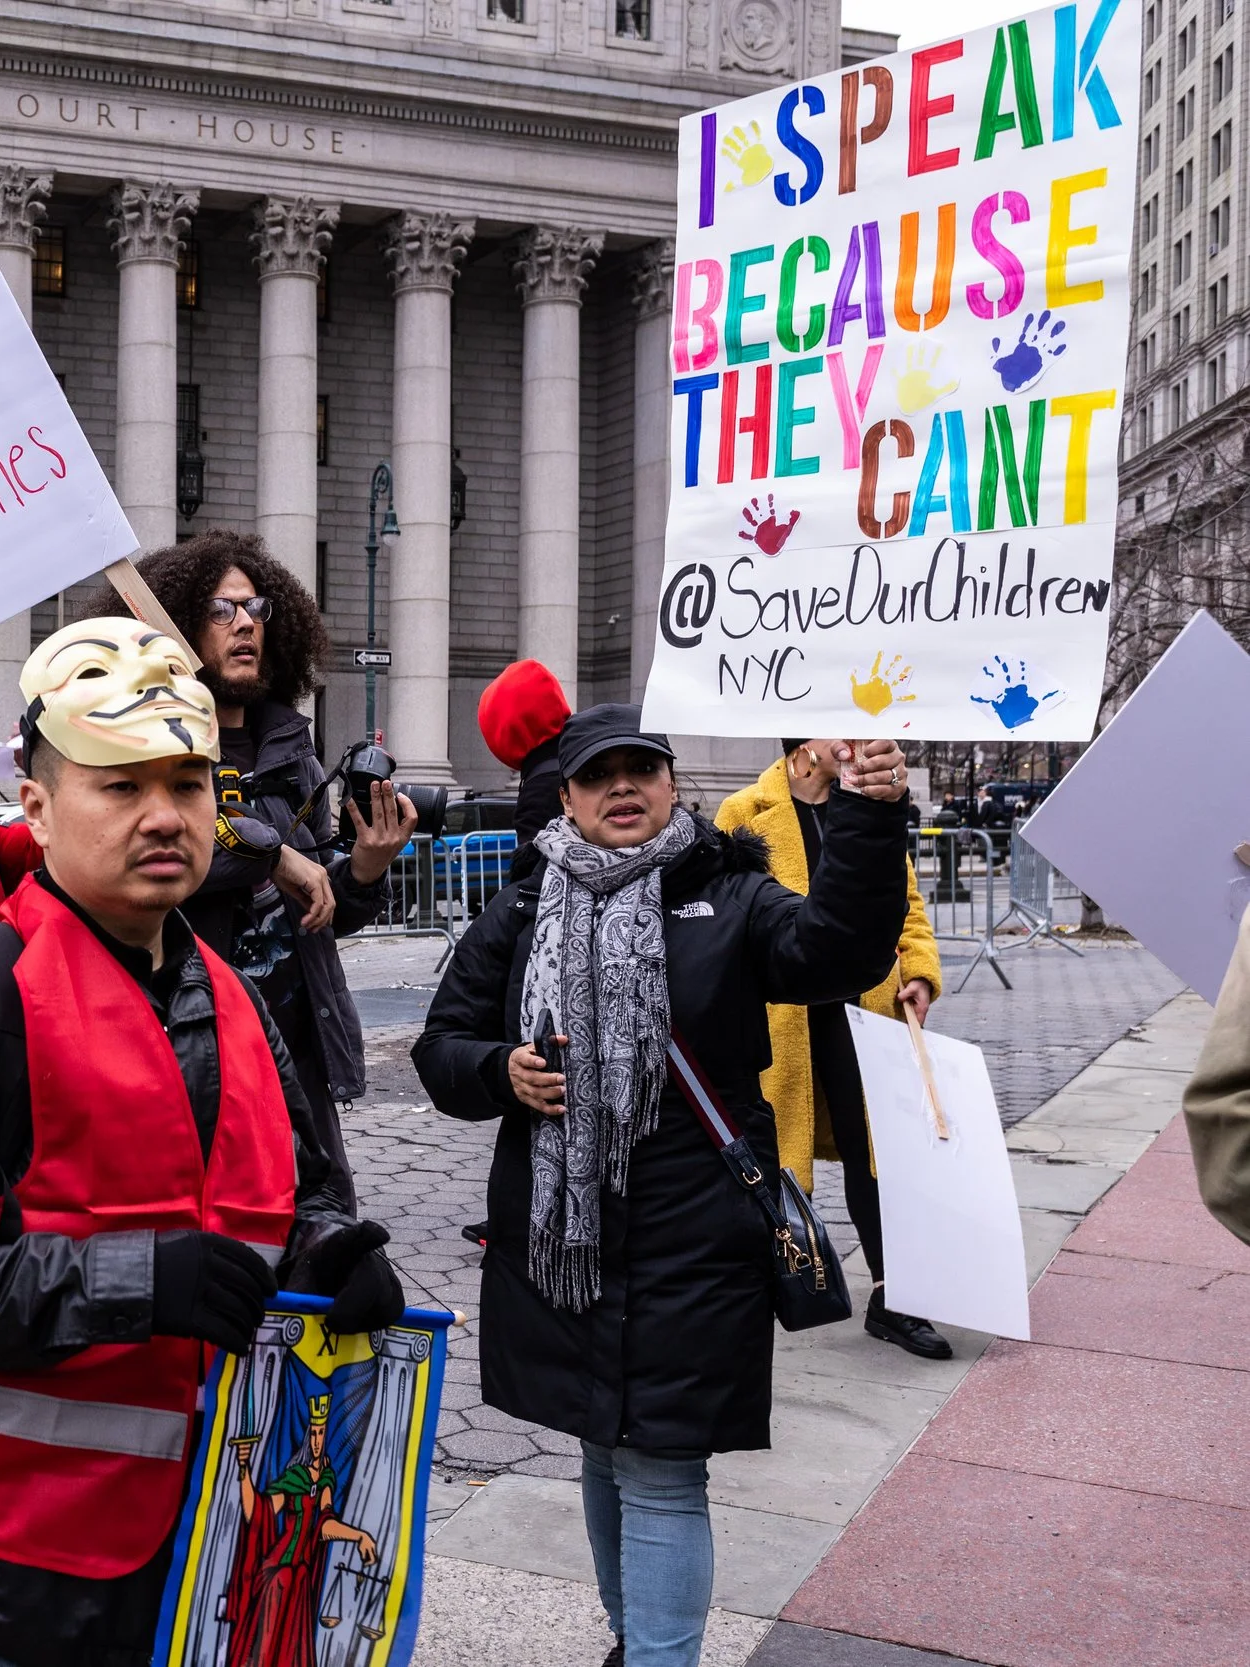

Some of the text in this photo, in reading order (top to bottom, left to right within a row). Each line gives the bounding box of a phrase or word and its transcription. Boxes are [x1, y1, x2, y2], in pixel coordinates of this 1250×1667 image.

[197, 115, 344, 154] HOUSE
[698, 0, 1123, 229] I SPEAK
[673, 168, 1108, 374] BECAUSE
[673, 344, 1117, 539] THEY CANT
[718, 646, 812, 702] NYC
[671, 906, 699, 915] NORTH
[683, 902, 699, 910] THE
